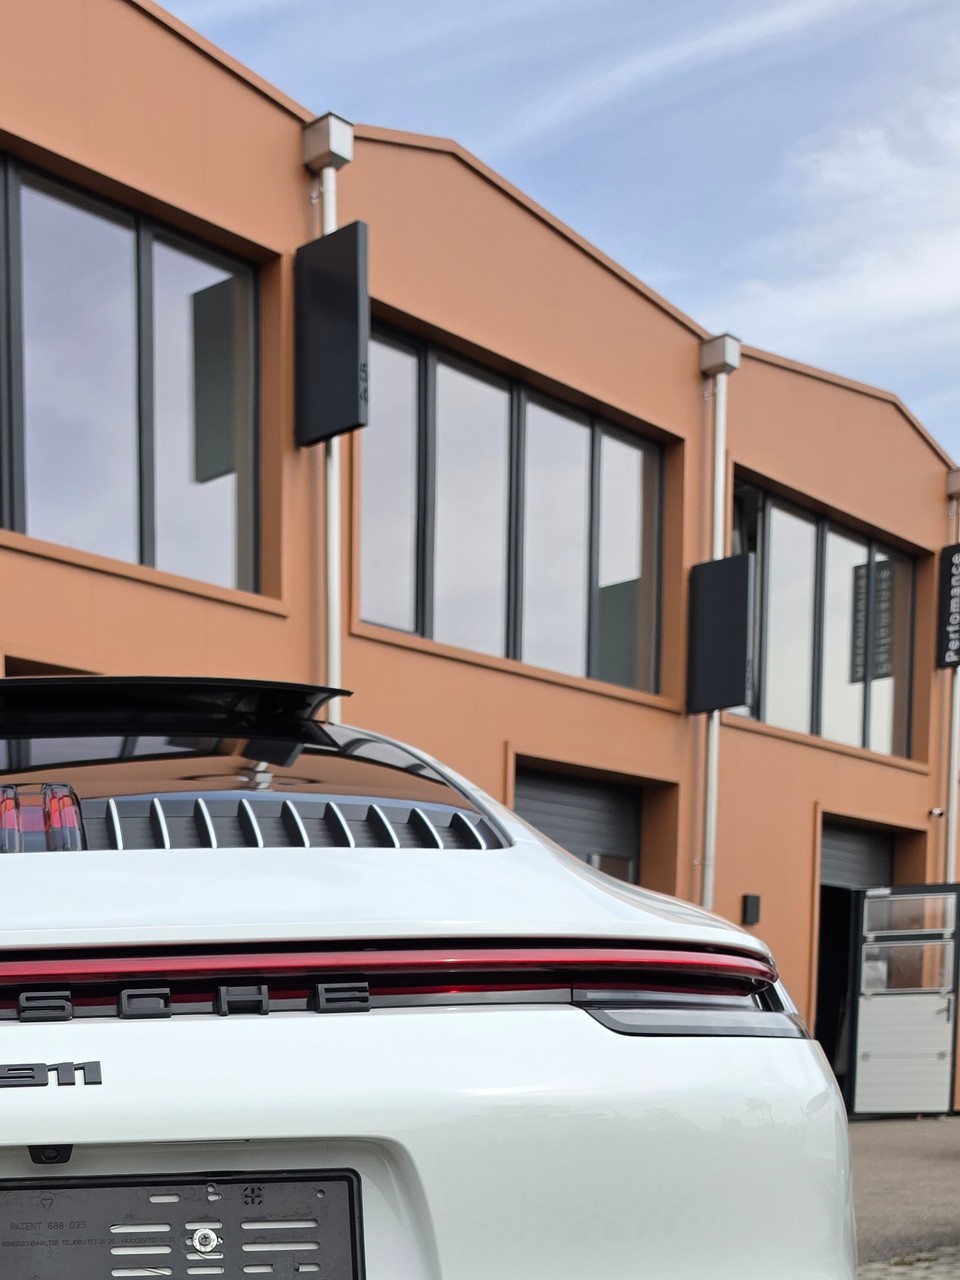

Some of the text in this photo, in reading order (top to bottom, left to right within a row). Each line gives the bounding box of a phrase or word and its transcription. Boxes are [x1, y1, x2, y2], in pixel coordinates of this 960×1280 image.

[10, 1220, 87, 1231] PATENT 688 035
